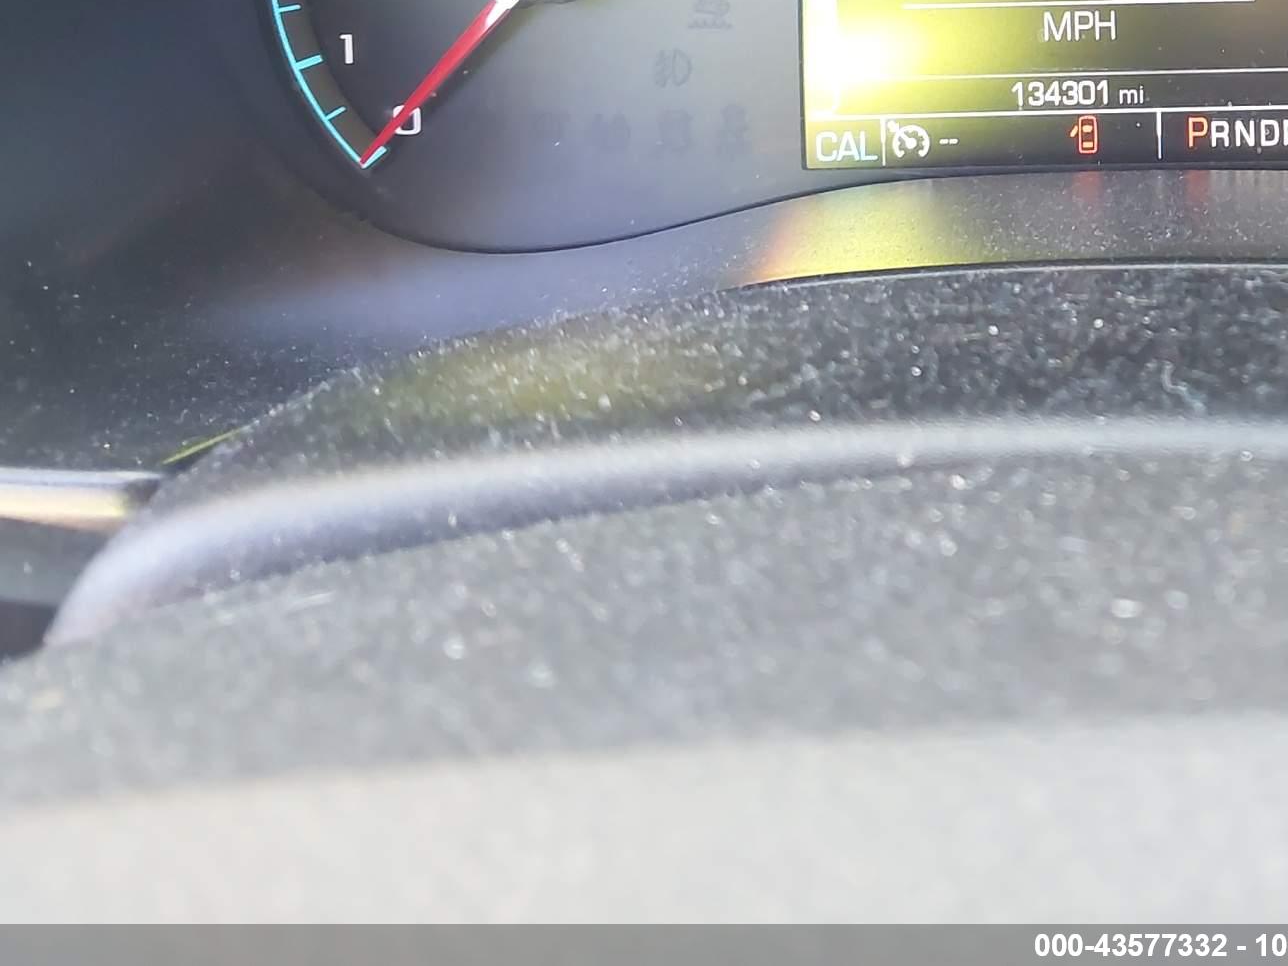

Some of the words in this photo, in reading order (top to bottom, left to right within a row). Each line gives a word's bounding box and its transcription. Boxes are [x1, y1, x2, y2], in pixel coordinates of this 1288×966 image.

[1043, 10, 1116, 42] MPH
[339, 34, 354, 64] 1
[1011, 80, 1111, 107] 134301
[1118, 85, 1145, 106] mi
[392, 104, 422, 135] 0
[815, 130, 878, 162] CAL
